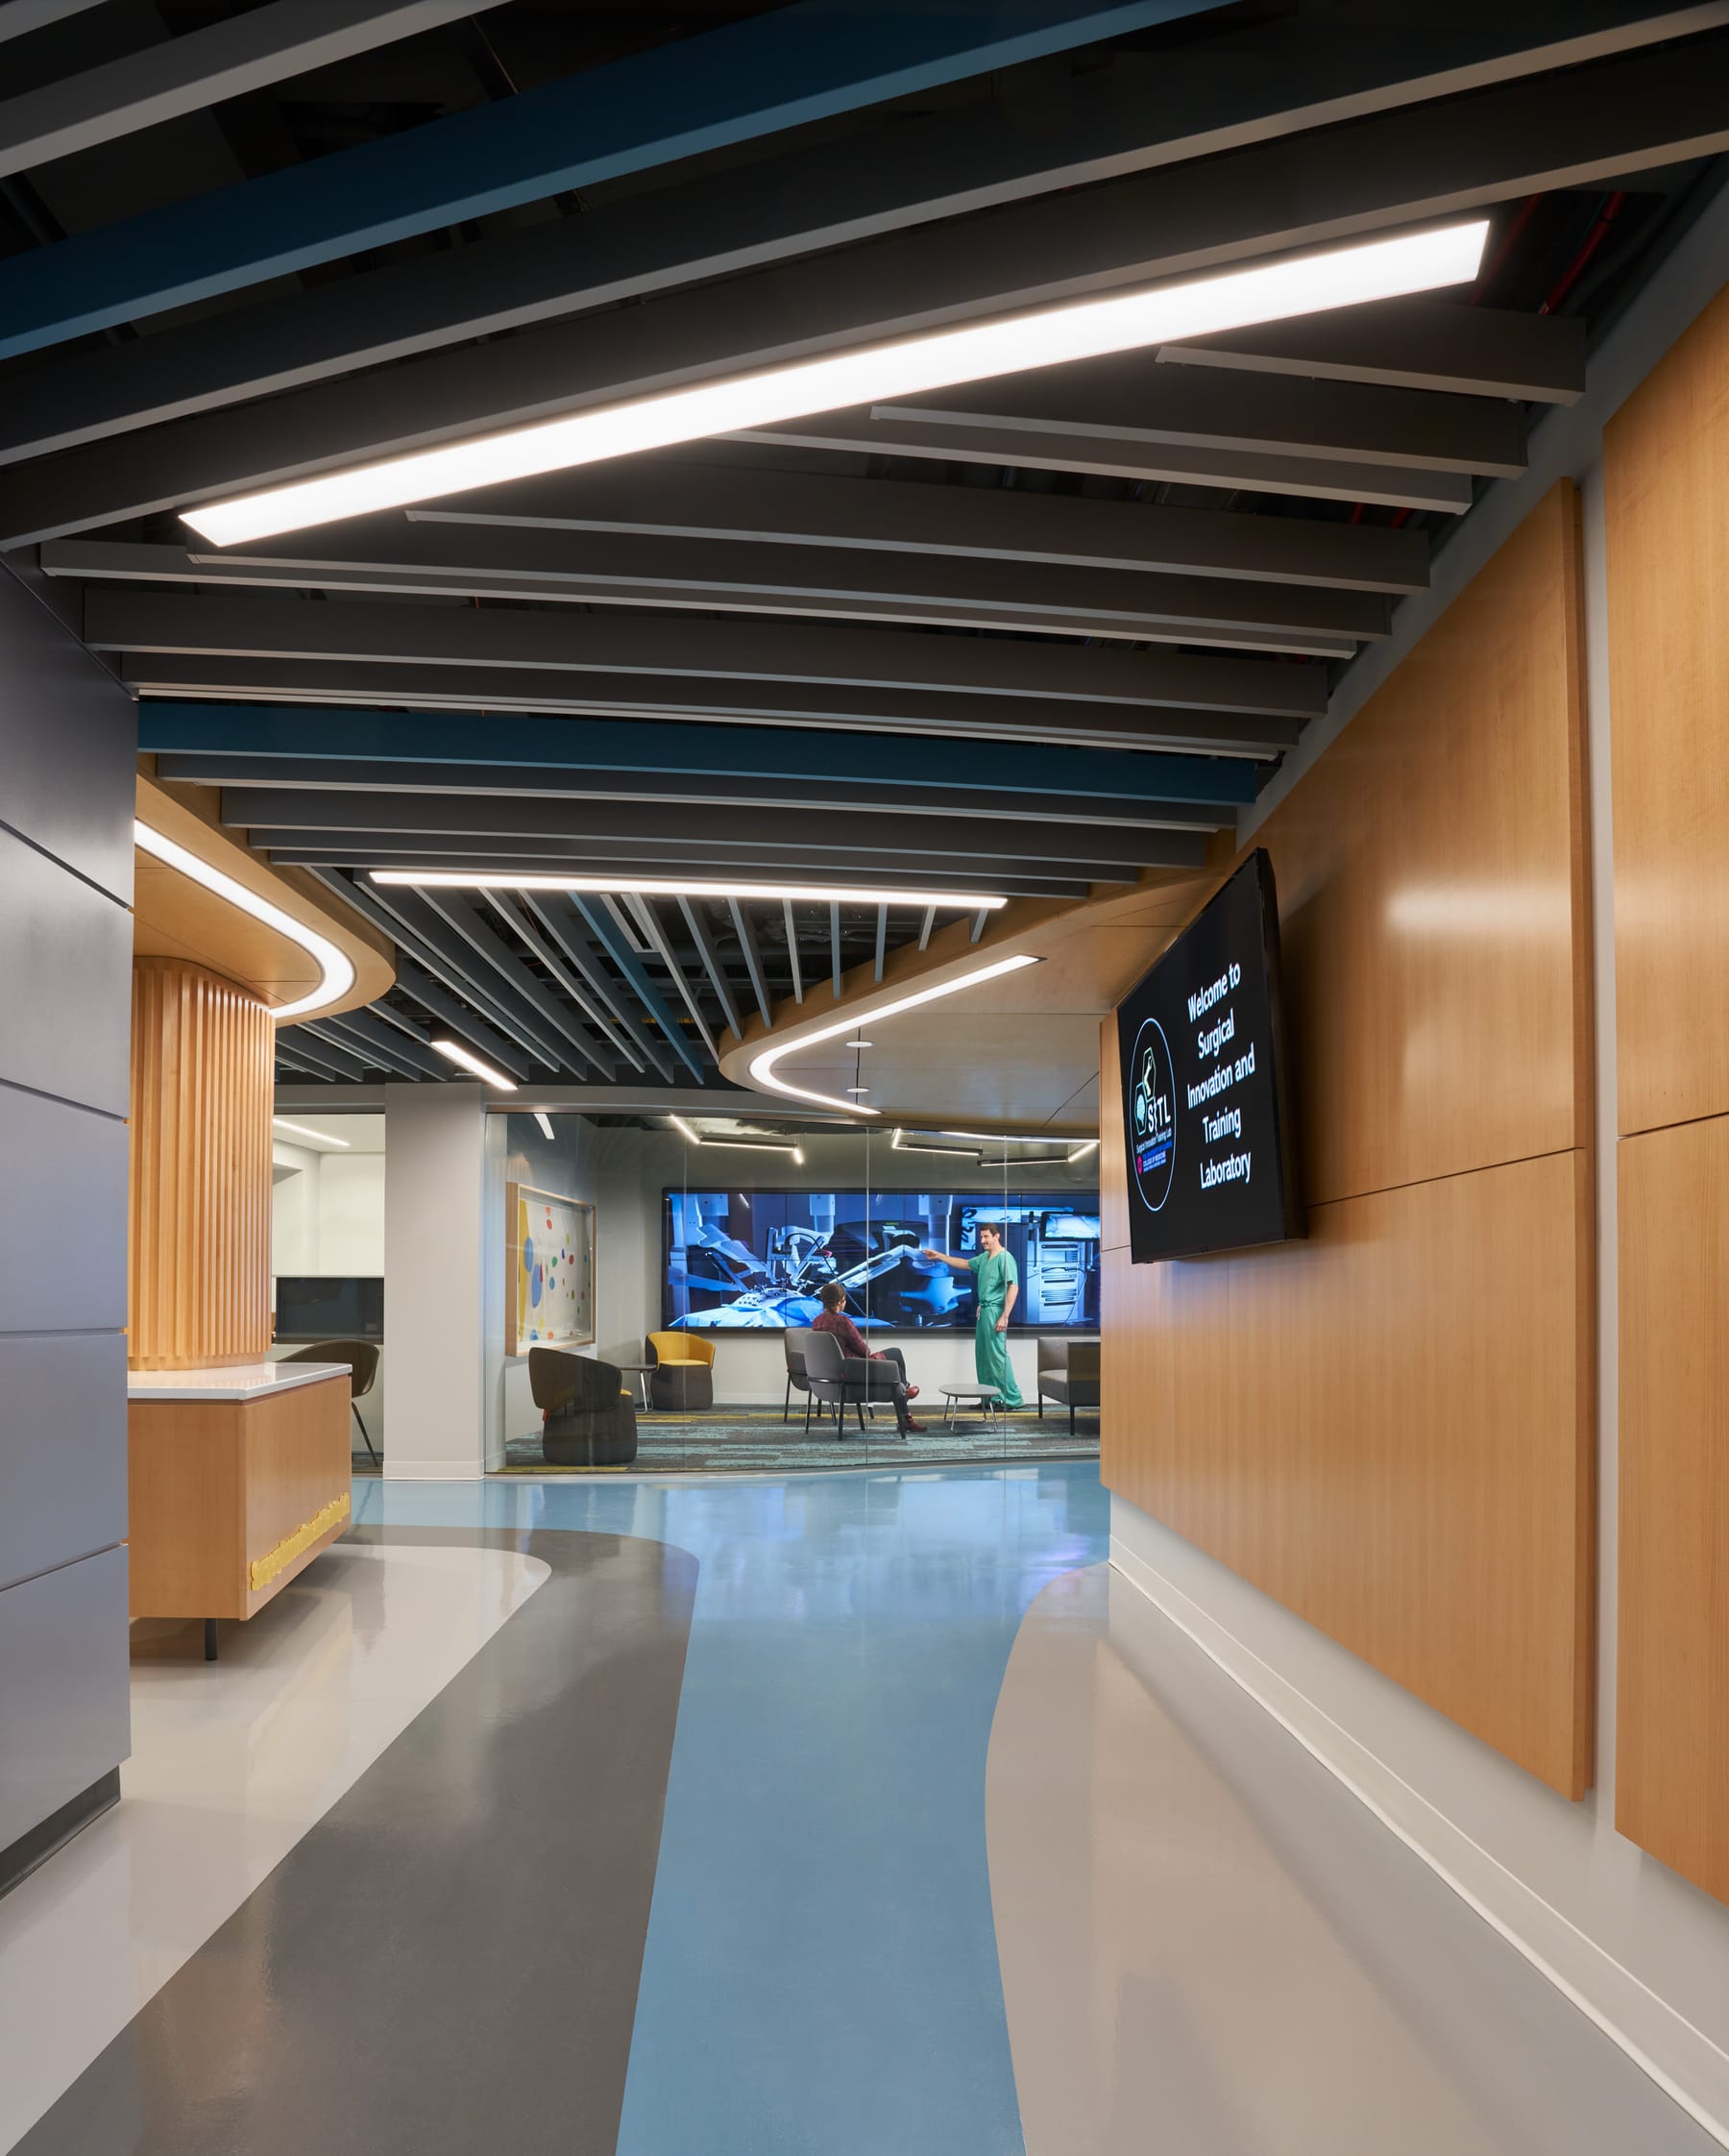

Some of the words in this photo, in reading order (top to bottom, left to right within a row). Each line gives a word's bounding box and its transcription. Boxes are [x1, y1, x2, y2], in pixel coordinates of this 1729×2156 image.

[1187, 973, 1229, 1023] Welcome
[1229, 962, 1241, 990] to
[1198, 1007, 1235, 1060] Surgical
[1186, 1064, 1233, 1110] Innovation
[1234, 1041, 1256, 1083] and
[1202, 1106, 1241, 1144] Training
[1200, 1151, 1252, 1190] Laboratory
